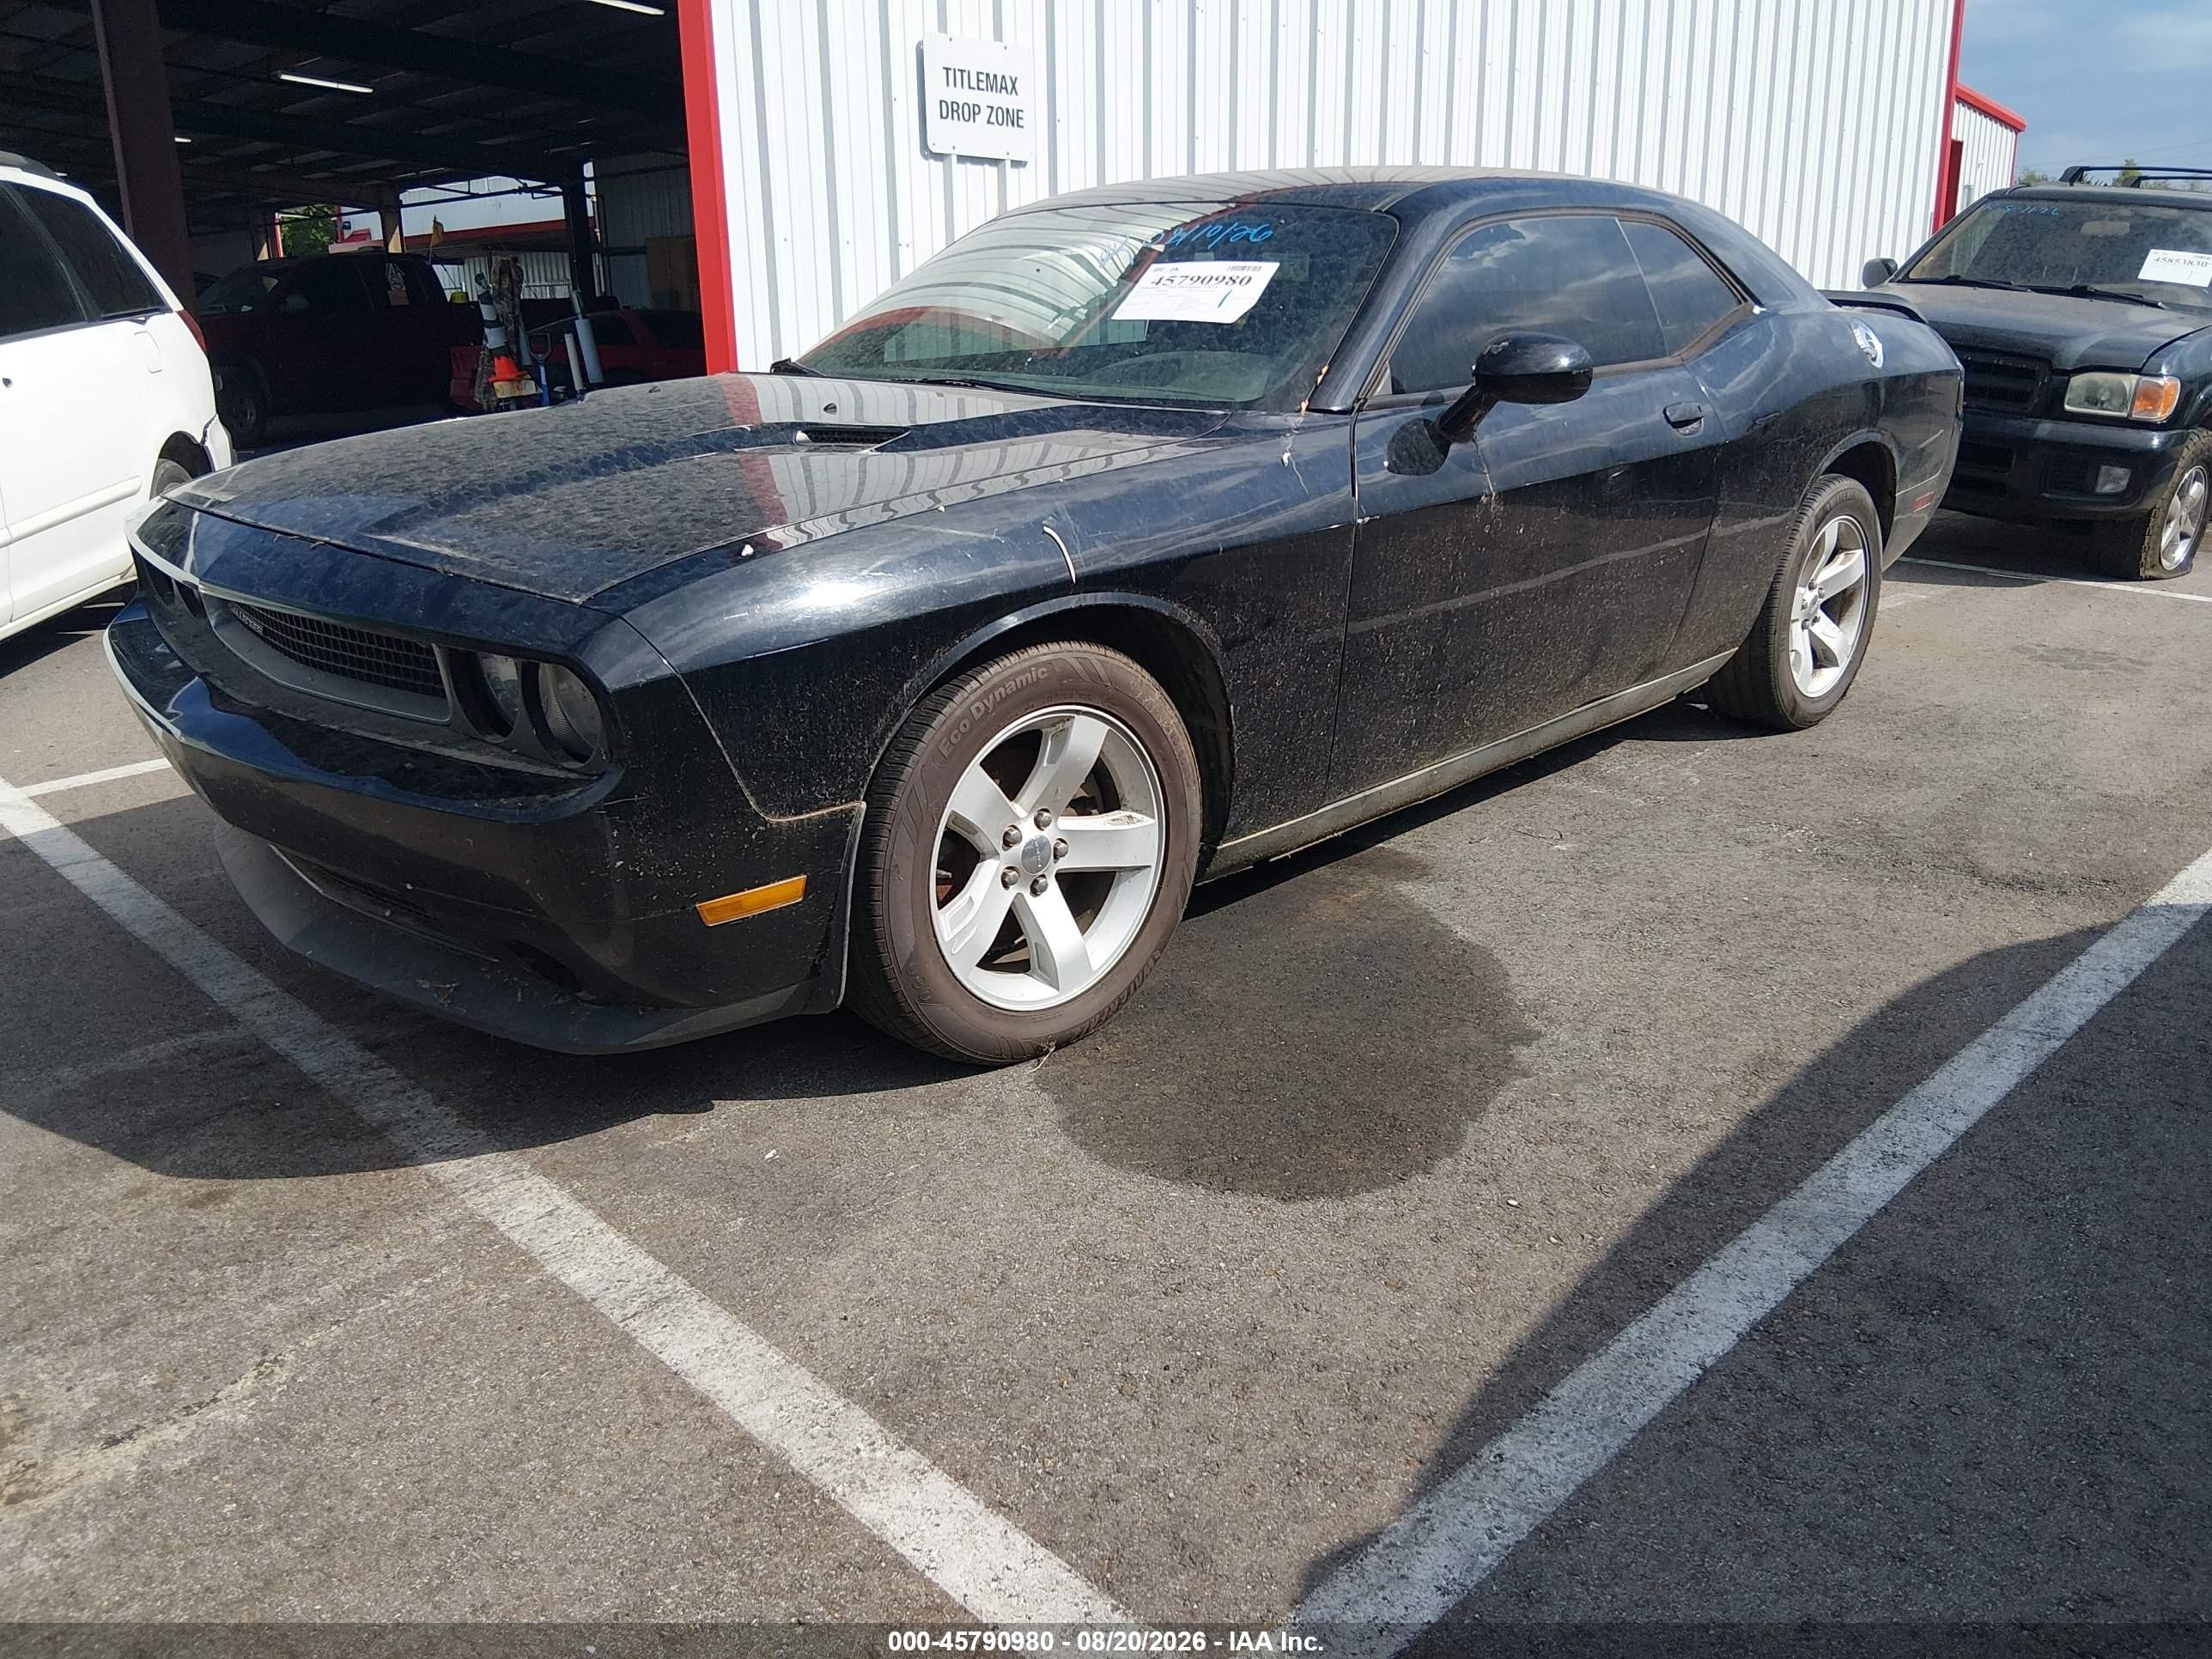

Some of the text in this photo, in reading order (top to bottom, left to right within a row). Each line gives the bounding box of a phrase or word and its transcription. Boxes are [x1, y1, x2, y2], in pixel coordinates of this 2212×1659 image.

[943, 66, 1018, 96] TITLEMAX
[939, 99, 1024, 129] DROP ZONE
[1151, 275, 1253, 287] 45790980
[939, 719, 972, 759] Eco
[970, 665, 1049, 721] Dynamic
